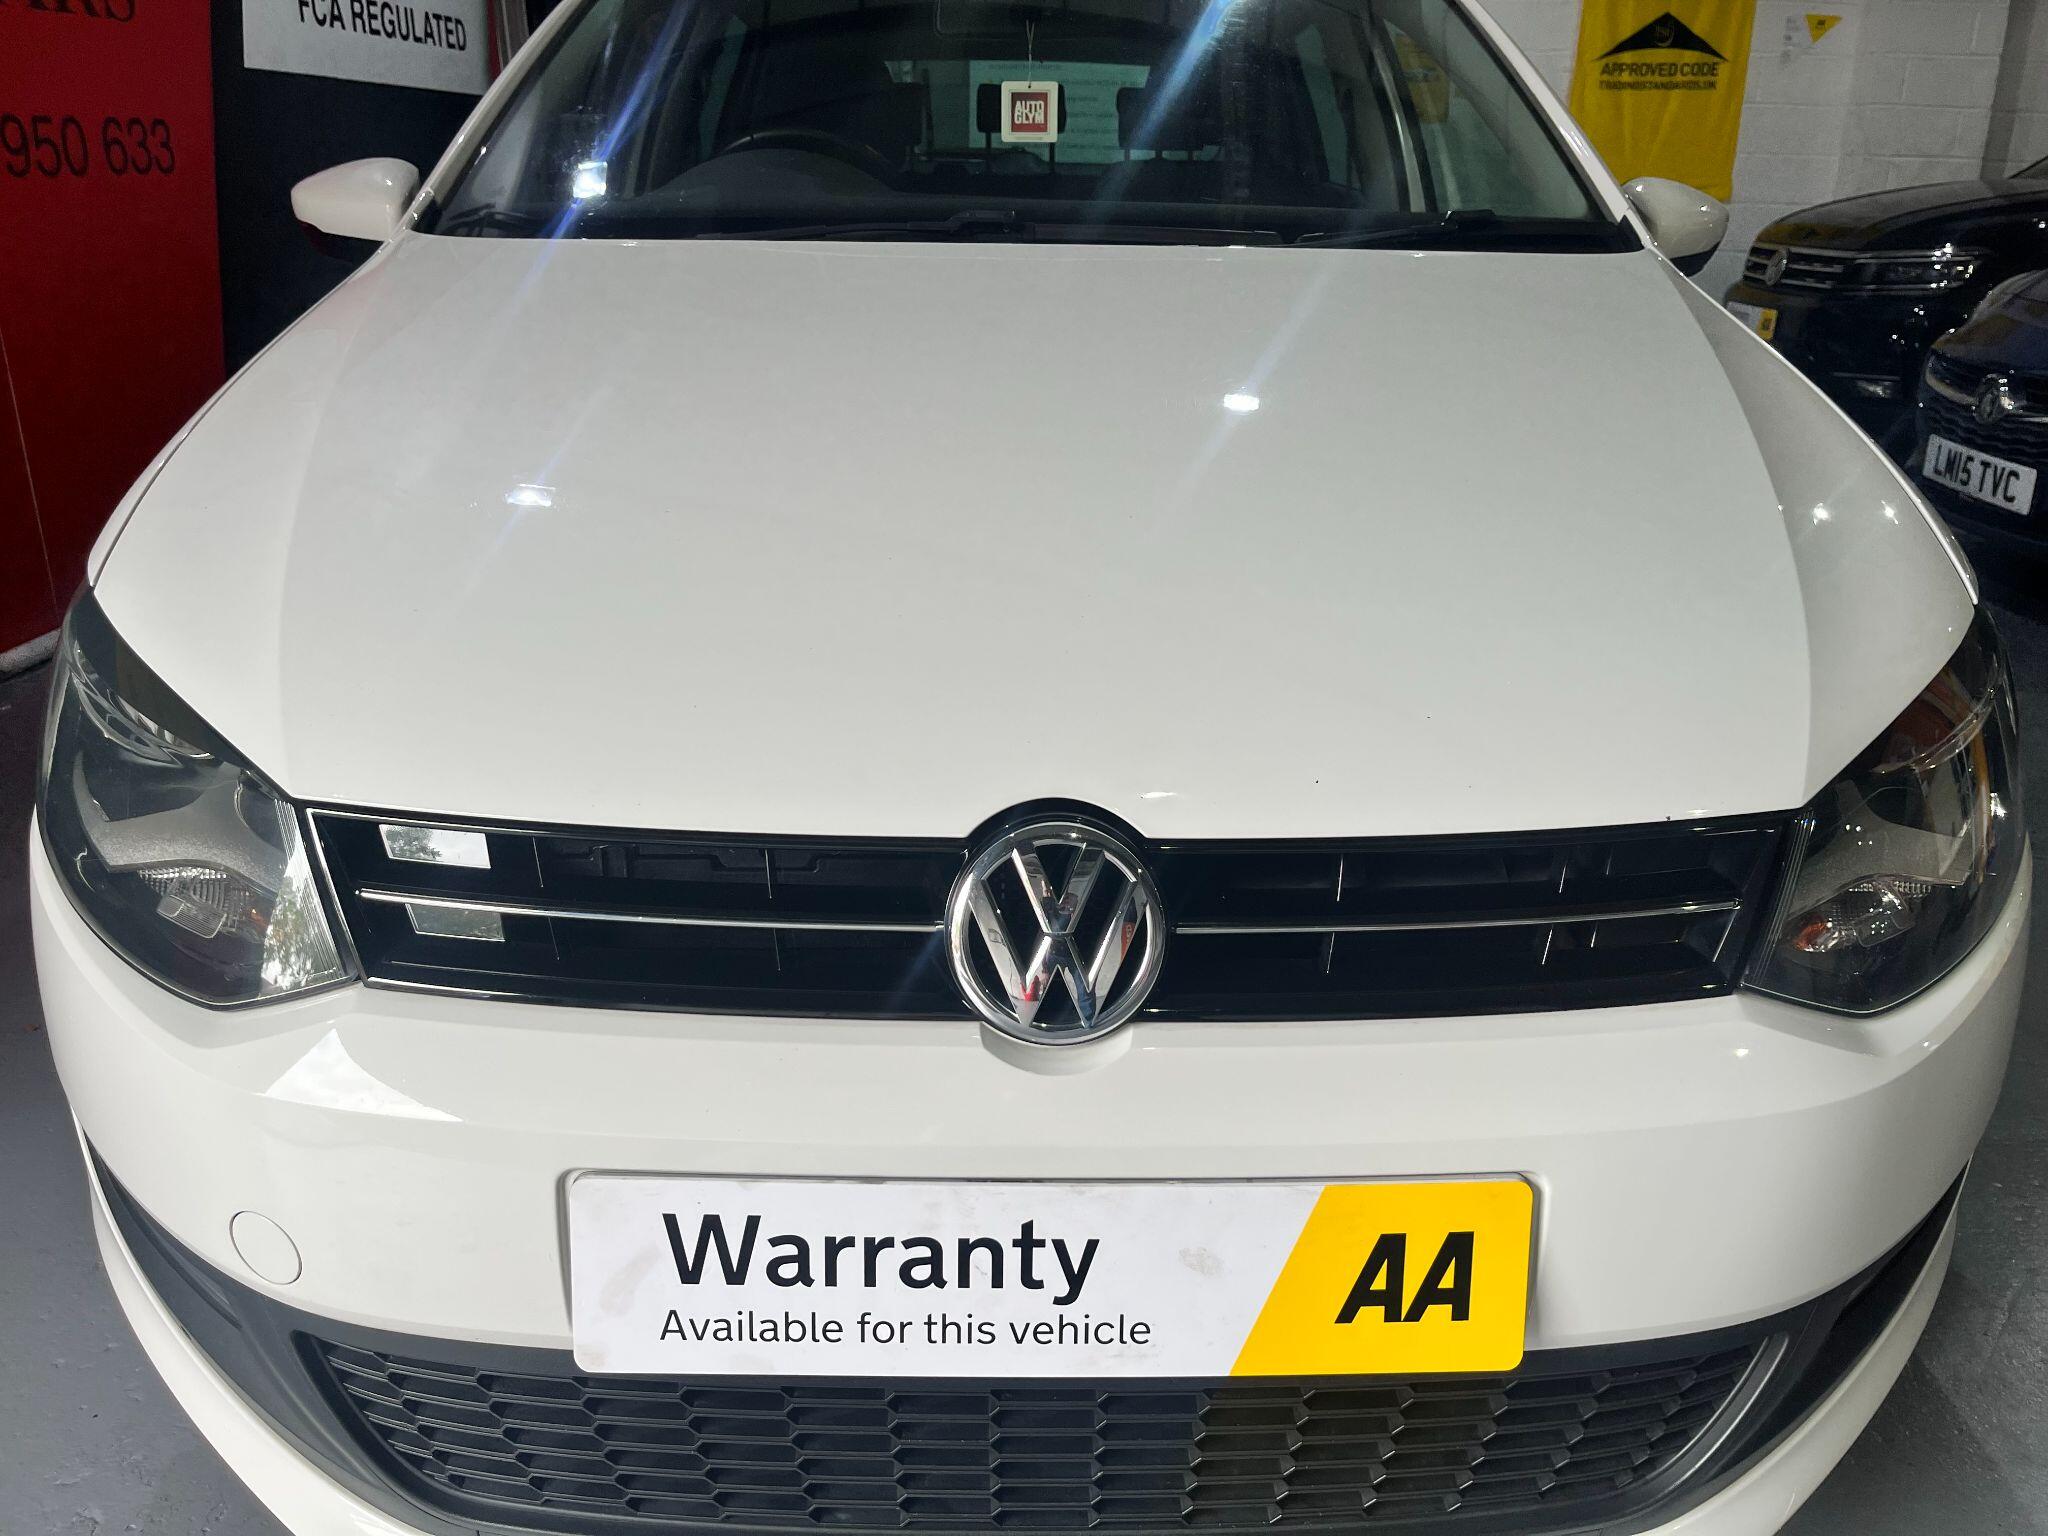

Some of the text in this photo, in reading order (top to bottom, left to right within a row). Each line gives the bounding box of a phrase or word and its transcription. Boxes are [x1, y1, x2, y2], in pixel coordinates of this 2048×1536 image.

[298, 0, 467, 51] FCA REGULATED
[1600, 62, 1719, 77] APPROVED CODE
[1014, 110, 1044, 124] GLYM
[1015, 100, 1044, 112] AUTO
[0, 113, 175, 178] 950 633
[1933, 444, 2020, 502] LM15 TVC
[662, 1213, 1100, 1306] Warranty
[1334, 1231, 1475, 1324] AA
[660, 1307, 1151, 1344] Available for this vehicle
